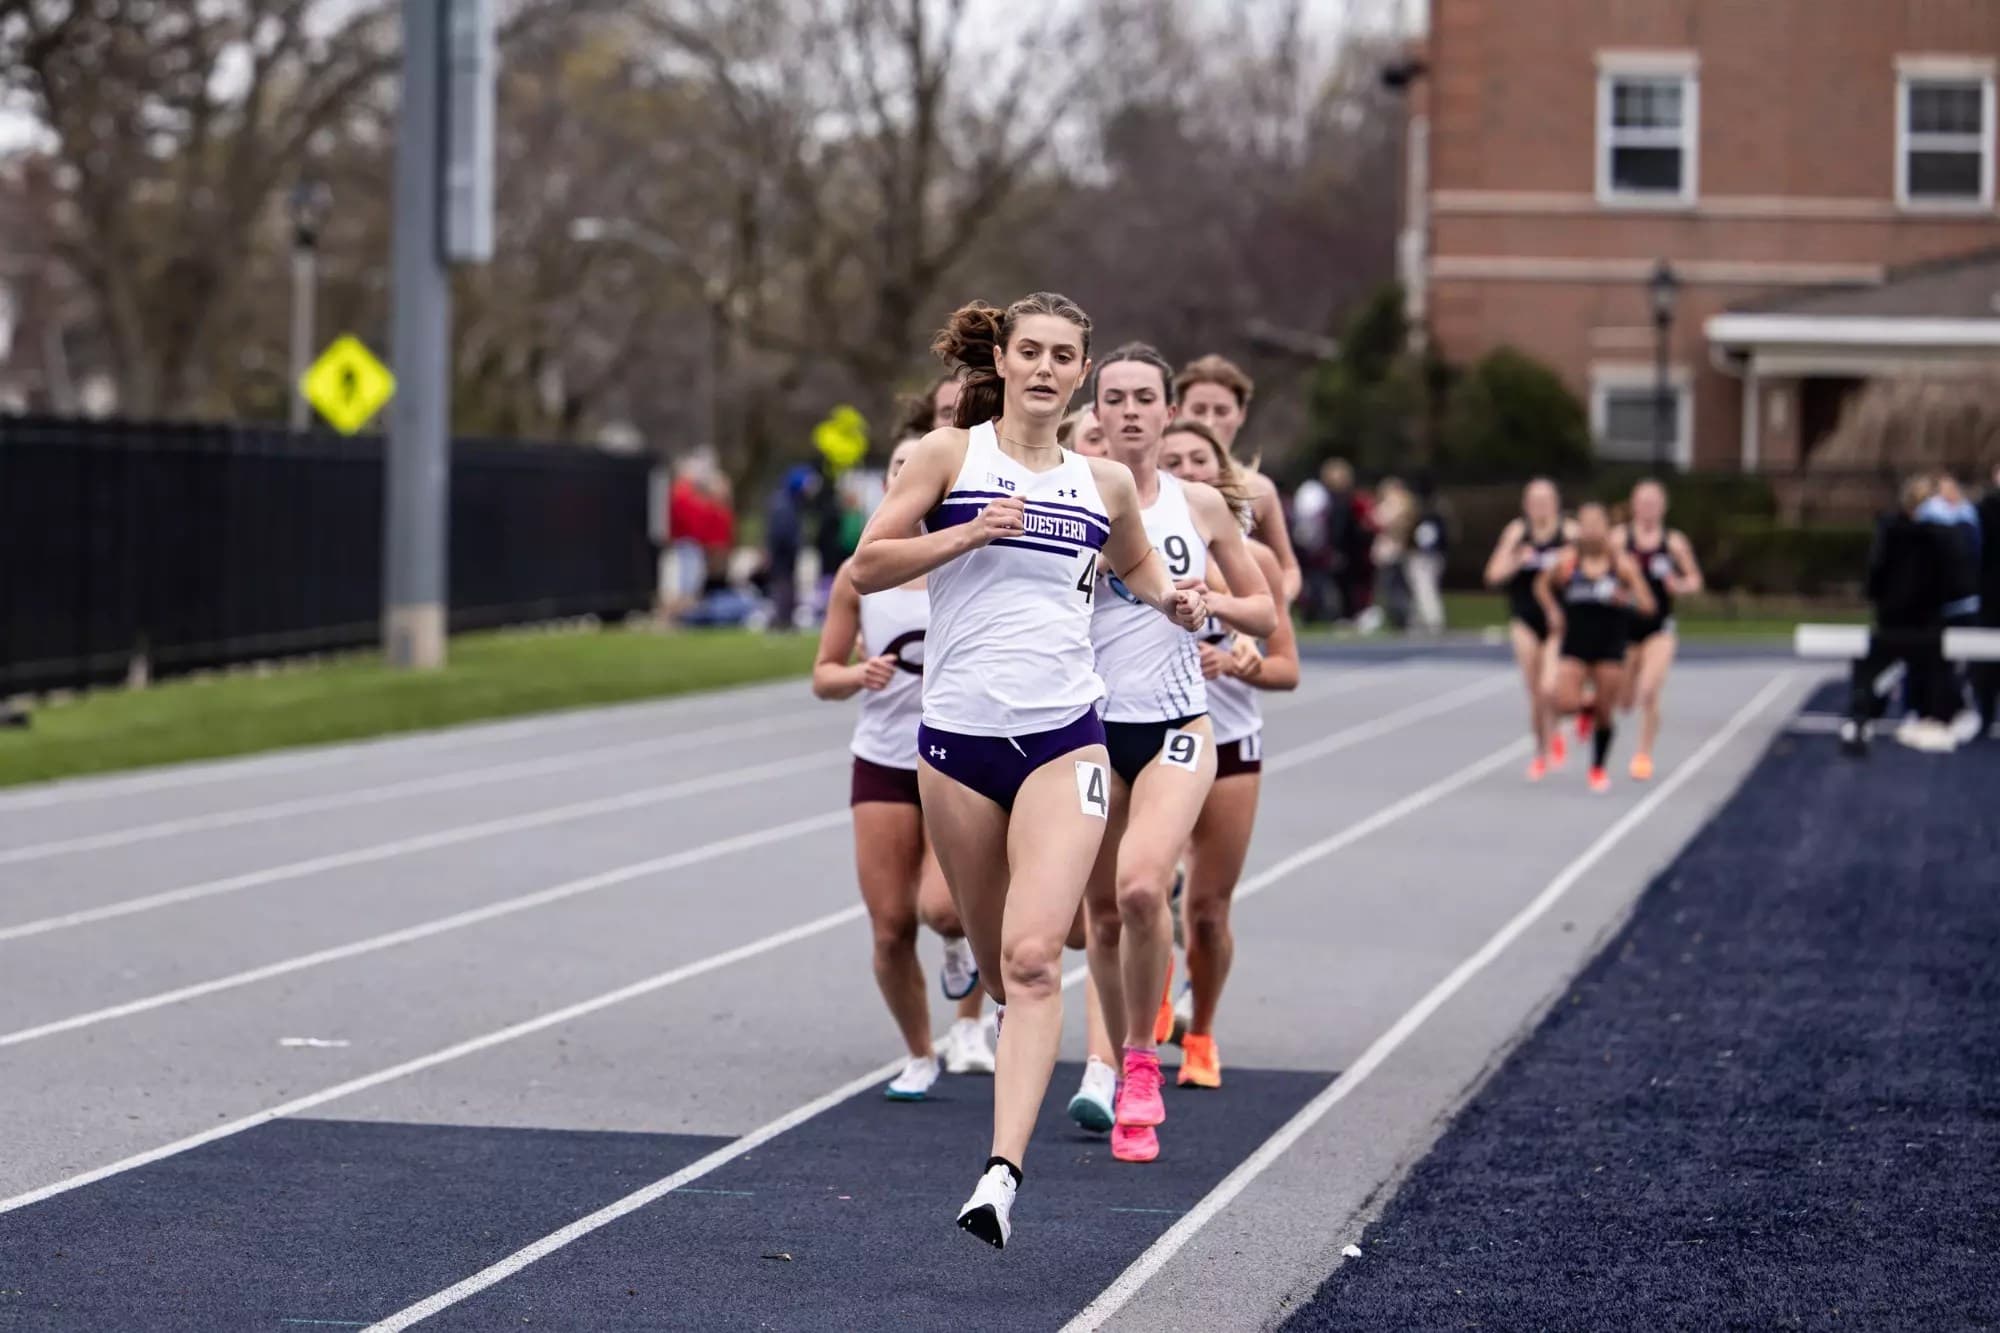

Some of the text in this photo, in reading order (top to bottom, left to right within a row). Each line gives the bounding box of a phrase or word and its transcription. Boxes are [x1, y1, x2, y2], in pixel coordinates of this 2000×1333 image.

[977, 510, 1087, 543] WESTERN
[1164, 535, 1191, 576] 9
[1077, 552, 1097, 604] 4
[1168, 734, 1196, 764] 9
[1087, 767, 1107, 816] 4
